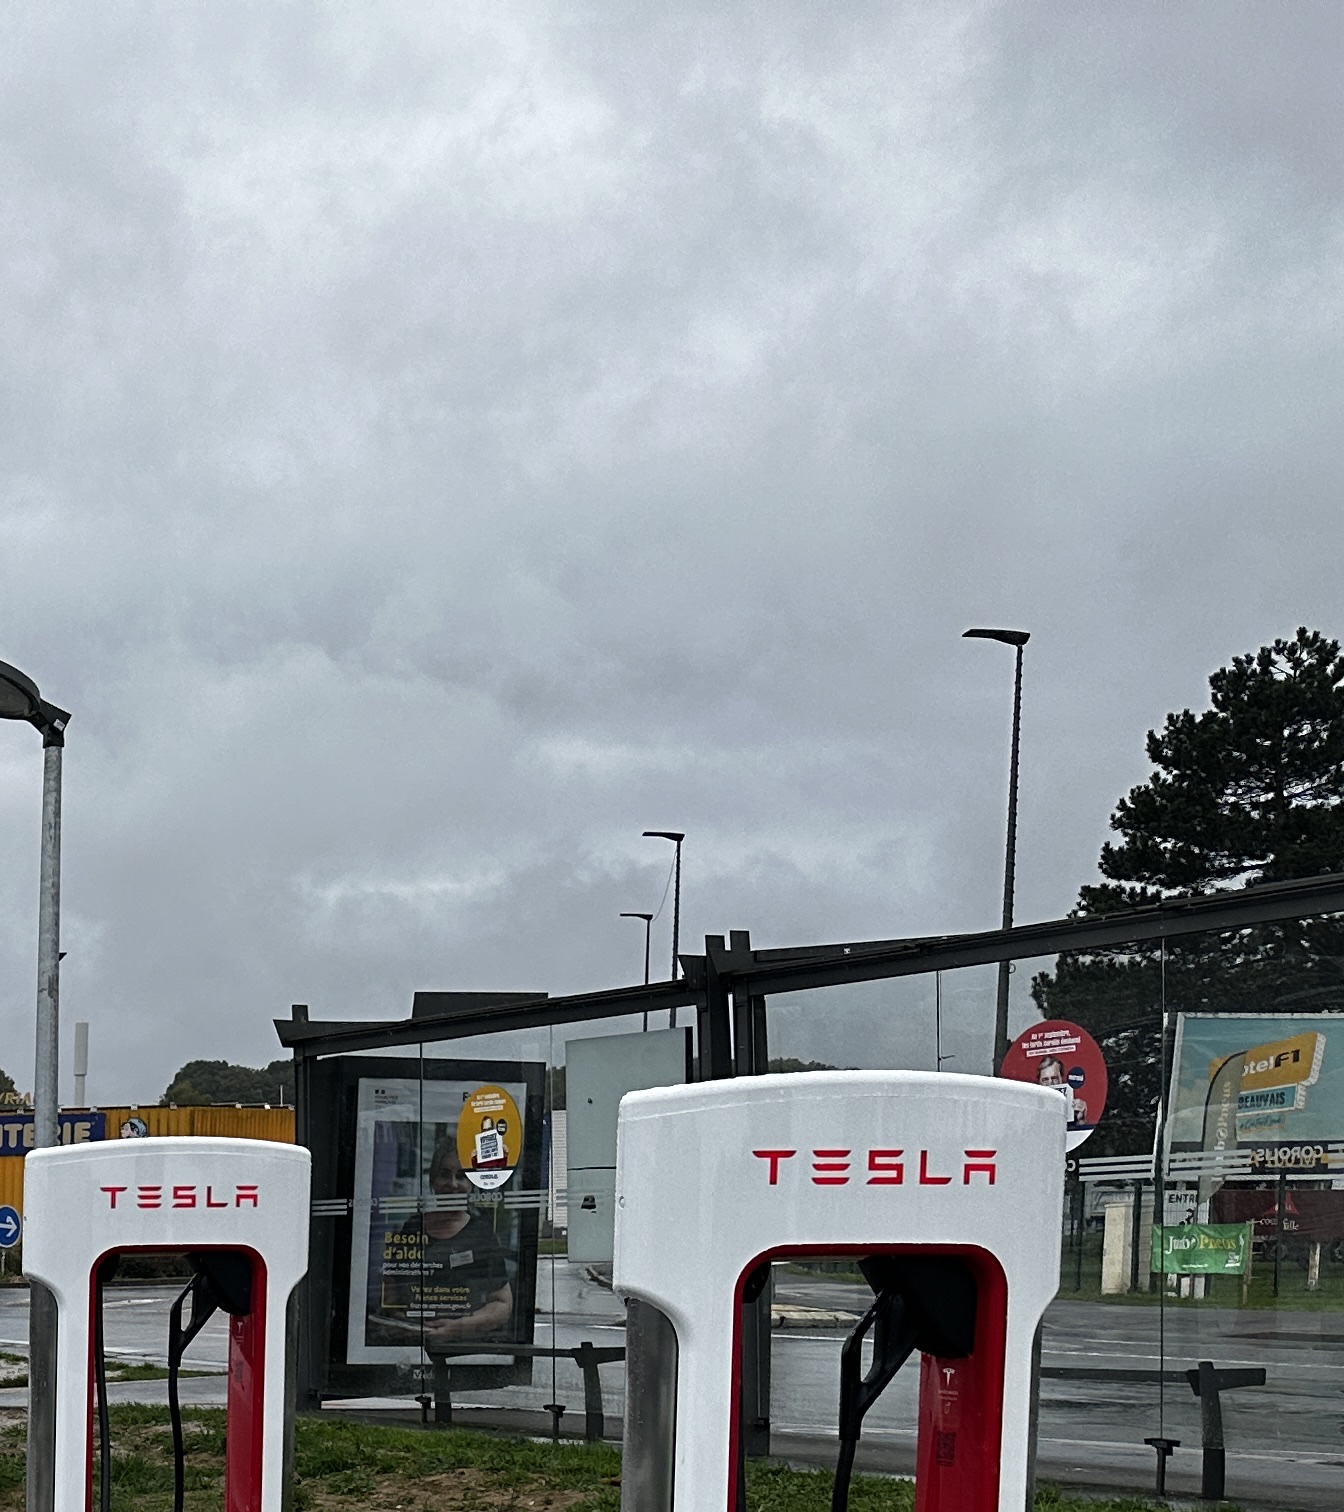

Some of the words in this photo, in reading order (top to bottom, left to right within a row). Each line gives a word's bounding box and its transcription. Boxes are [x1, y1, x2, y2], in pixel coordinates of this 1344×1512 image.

[1241, 1048, 1301, 1077] telF1
[752, 1149, 997, 1186] TESLA
[100, 1184, 259, 1210] TESLA
[1168, 1193, 1196, 1204] ENTR
[384, 1230, 429, 1245] Besoin
[411, 1285, 432, 1293] Veez
[415, 1294, 438, 1302] Frnce
